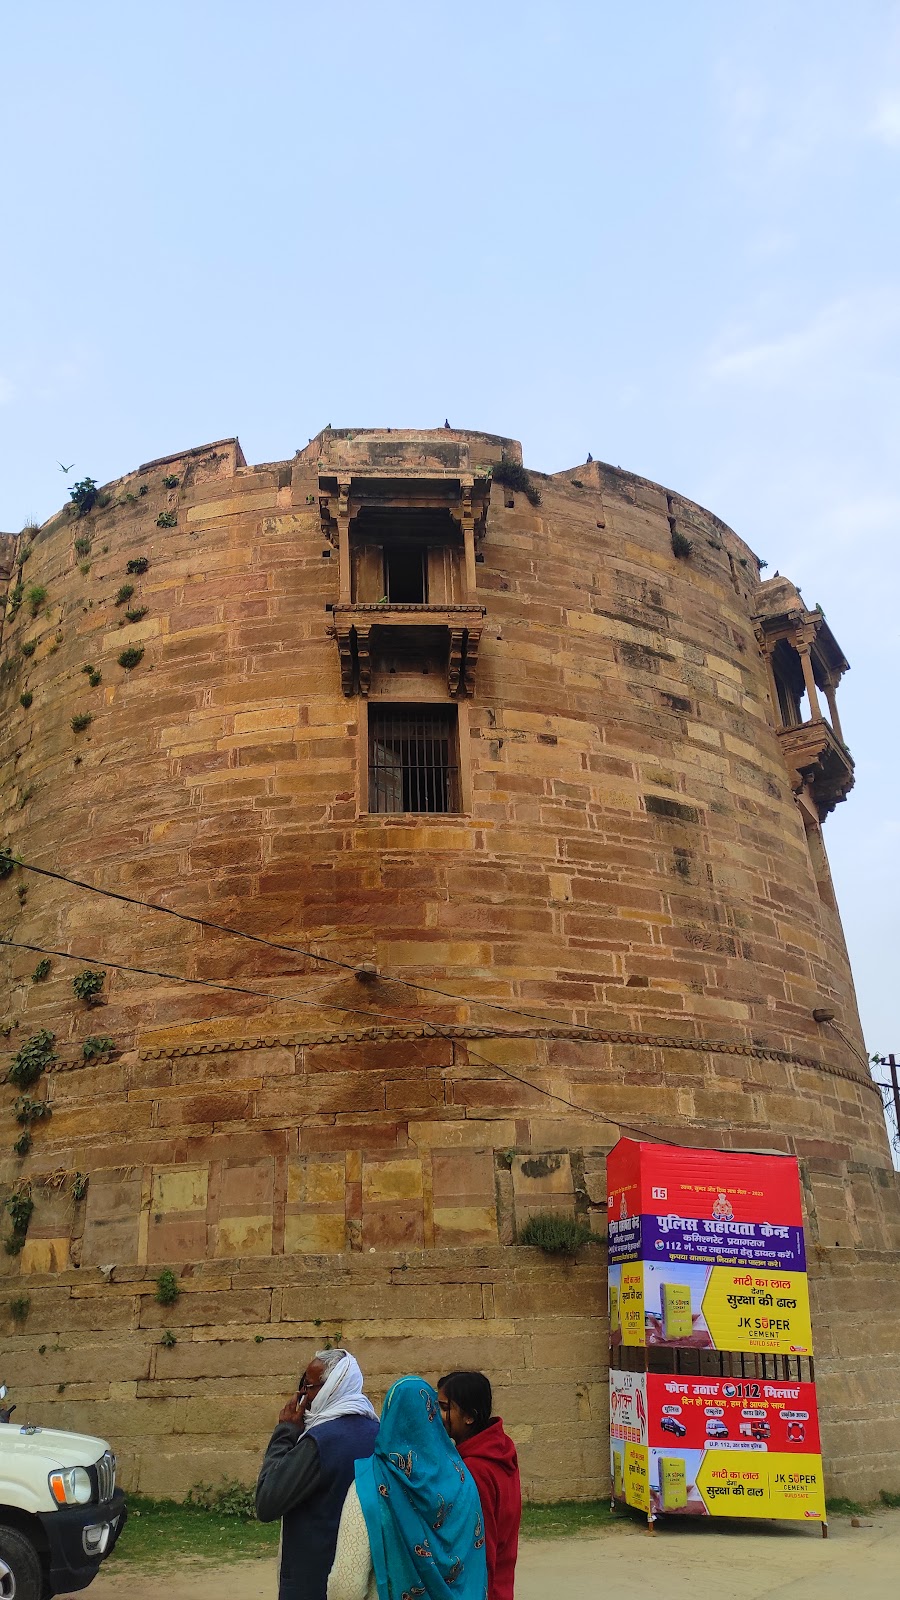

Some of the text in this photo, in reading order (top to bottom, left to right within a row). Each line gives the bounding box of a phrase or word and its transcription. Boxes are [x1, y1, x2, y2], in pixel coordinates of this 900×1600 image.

[654, 1189, 666, 1198] 15
[656, 1214, 698, 1233] पुलिस
[702, 1220, 755, 1235] सहायता
[759, 1222, 790, 1238] केन्द्र
[683, 1232, 765, 1247] कमिश्नरेट प्रयागराज
[666, 1241, 681, 1250] 112
[708, 1246, 738, 1254] सहायता
[740, 1247, 753, 1258] हेतु
[716, 1255, 736, 1264] नियमों
[733, 1275, 791, 1289] माटी का लाल
[726, 1294, 798, 1309] सुरक्षा की ढाल
[738, 1317, 790, 1330] JK SUPER
[664, 1381, 800, 1398] फोन उठाएं 112 मिलाएं
[681, 1396, 694, 1405] दिन
[695, 1397, 702, 1406] हो
[750, 1400, 769, 1408] आपके
[712, 1469, 728, 1478] माटी
[775, 1473, 816, 1484] JK SUPER
[706, 1485, 764, 1498] सुरक्षा की ढाल
